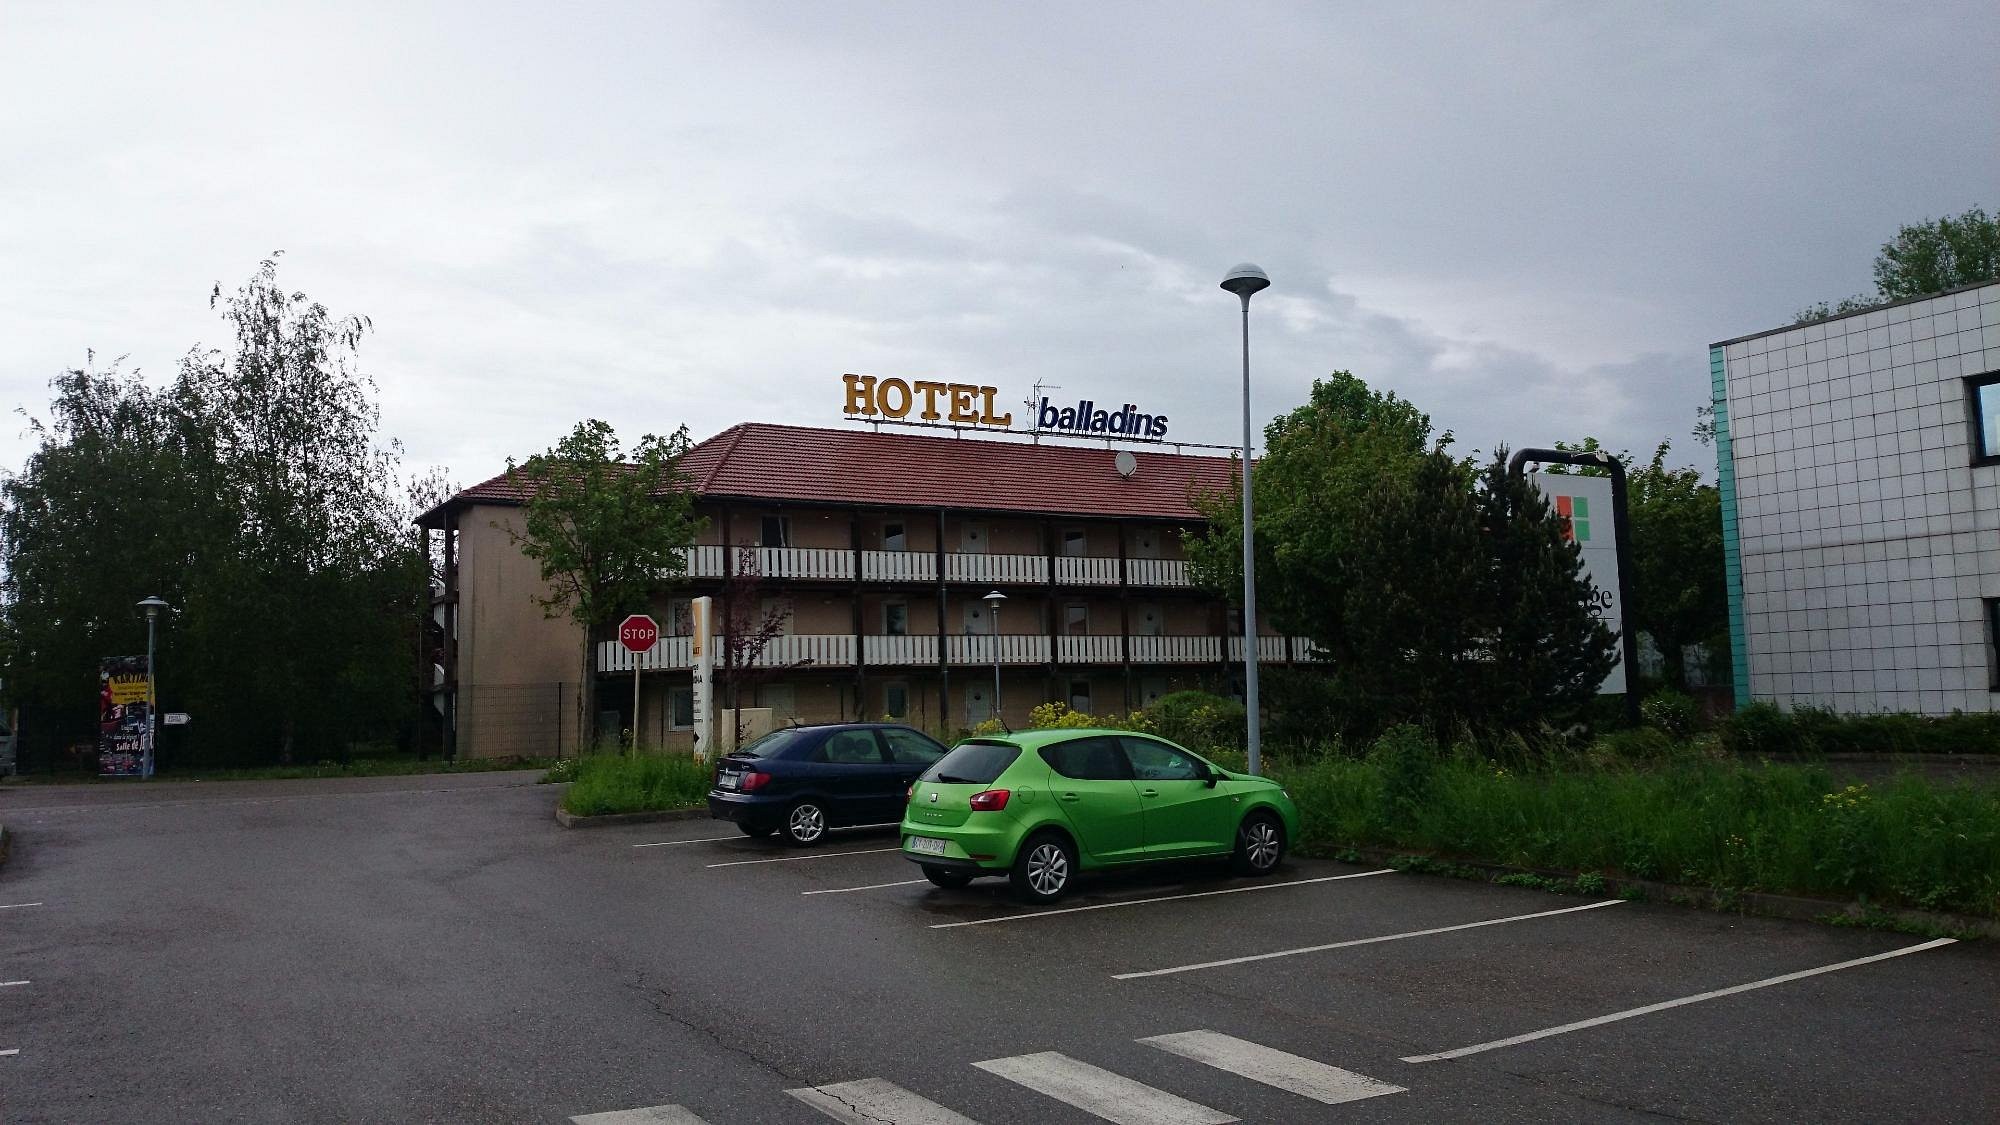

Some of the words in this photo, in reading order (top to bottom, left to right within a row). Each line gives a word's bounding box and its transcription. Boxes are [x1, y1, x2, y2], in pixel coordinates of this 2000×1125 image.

[842, 373, 1012, 426] HOTEL
[1038, 397, 1168, 440] balladins
[623, 628, 655, 640] STOP
